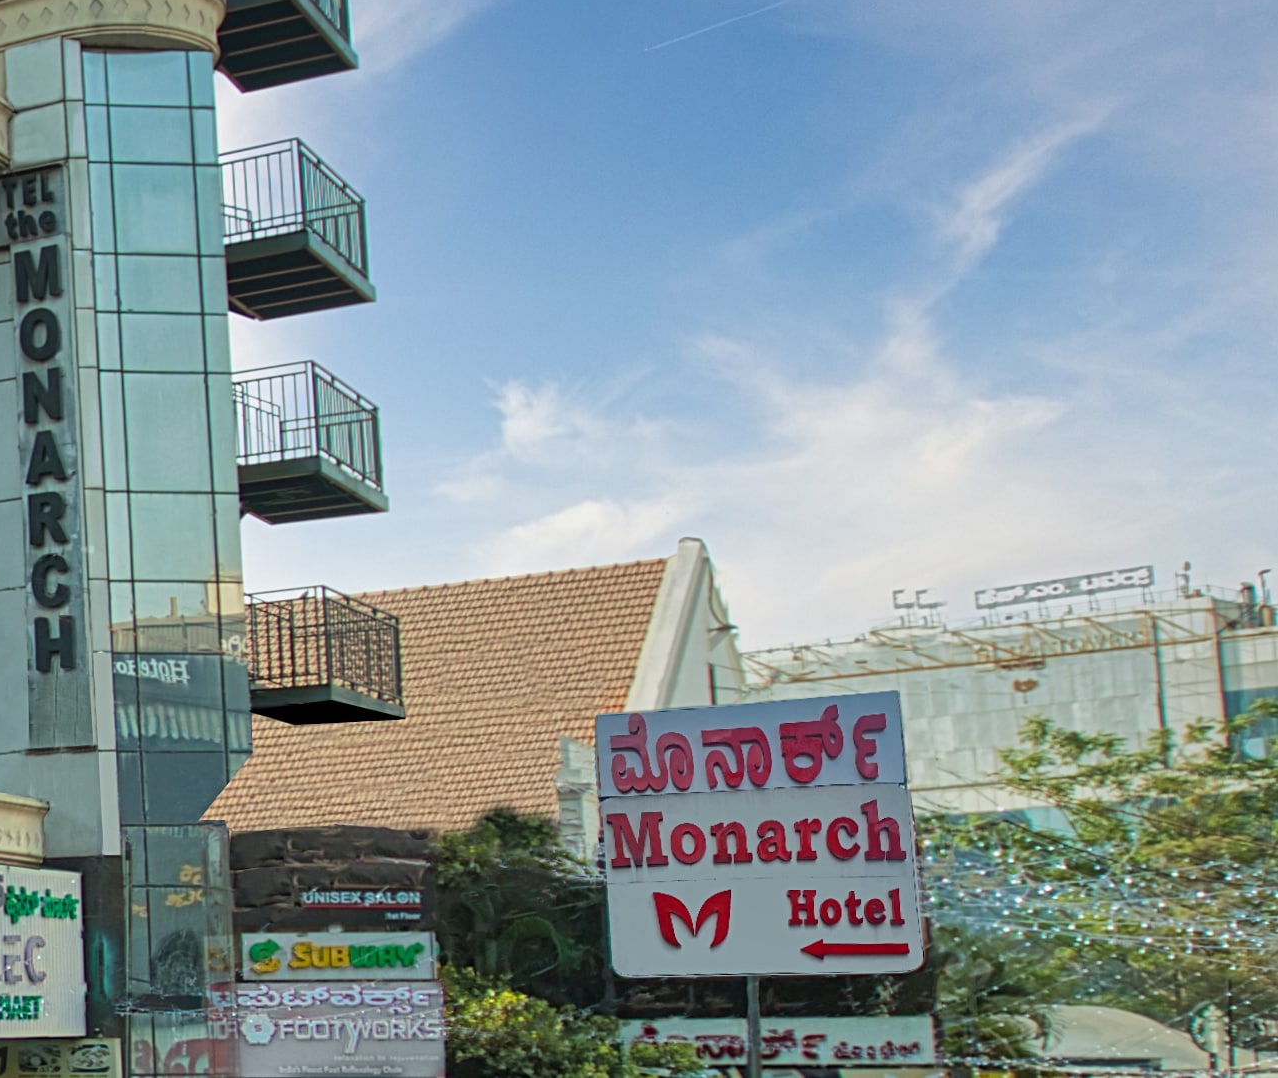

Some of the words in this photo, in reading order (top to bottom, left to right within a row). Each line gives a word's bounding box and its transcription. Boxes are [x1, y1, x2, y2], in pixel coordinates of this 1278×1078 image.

[5, 210, 57, 240] the
[14, 244, 77, 673] MONARCH
[606, 799, 907, 868] Monarch
[302, 891, 360, 904] UNISEX
[364, 891, 421, 905] SALON
[787, 888, 905, 926] Hotel
[289, 941, 424, 969] SUBWAY
